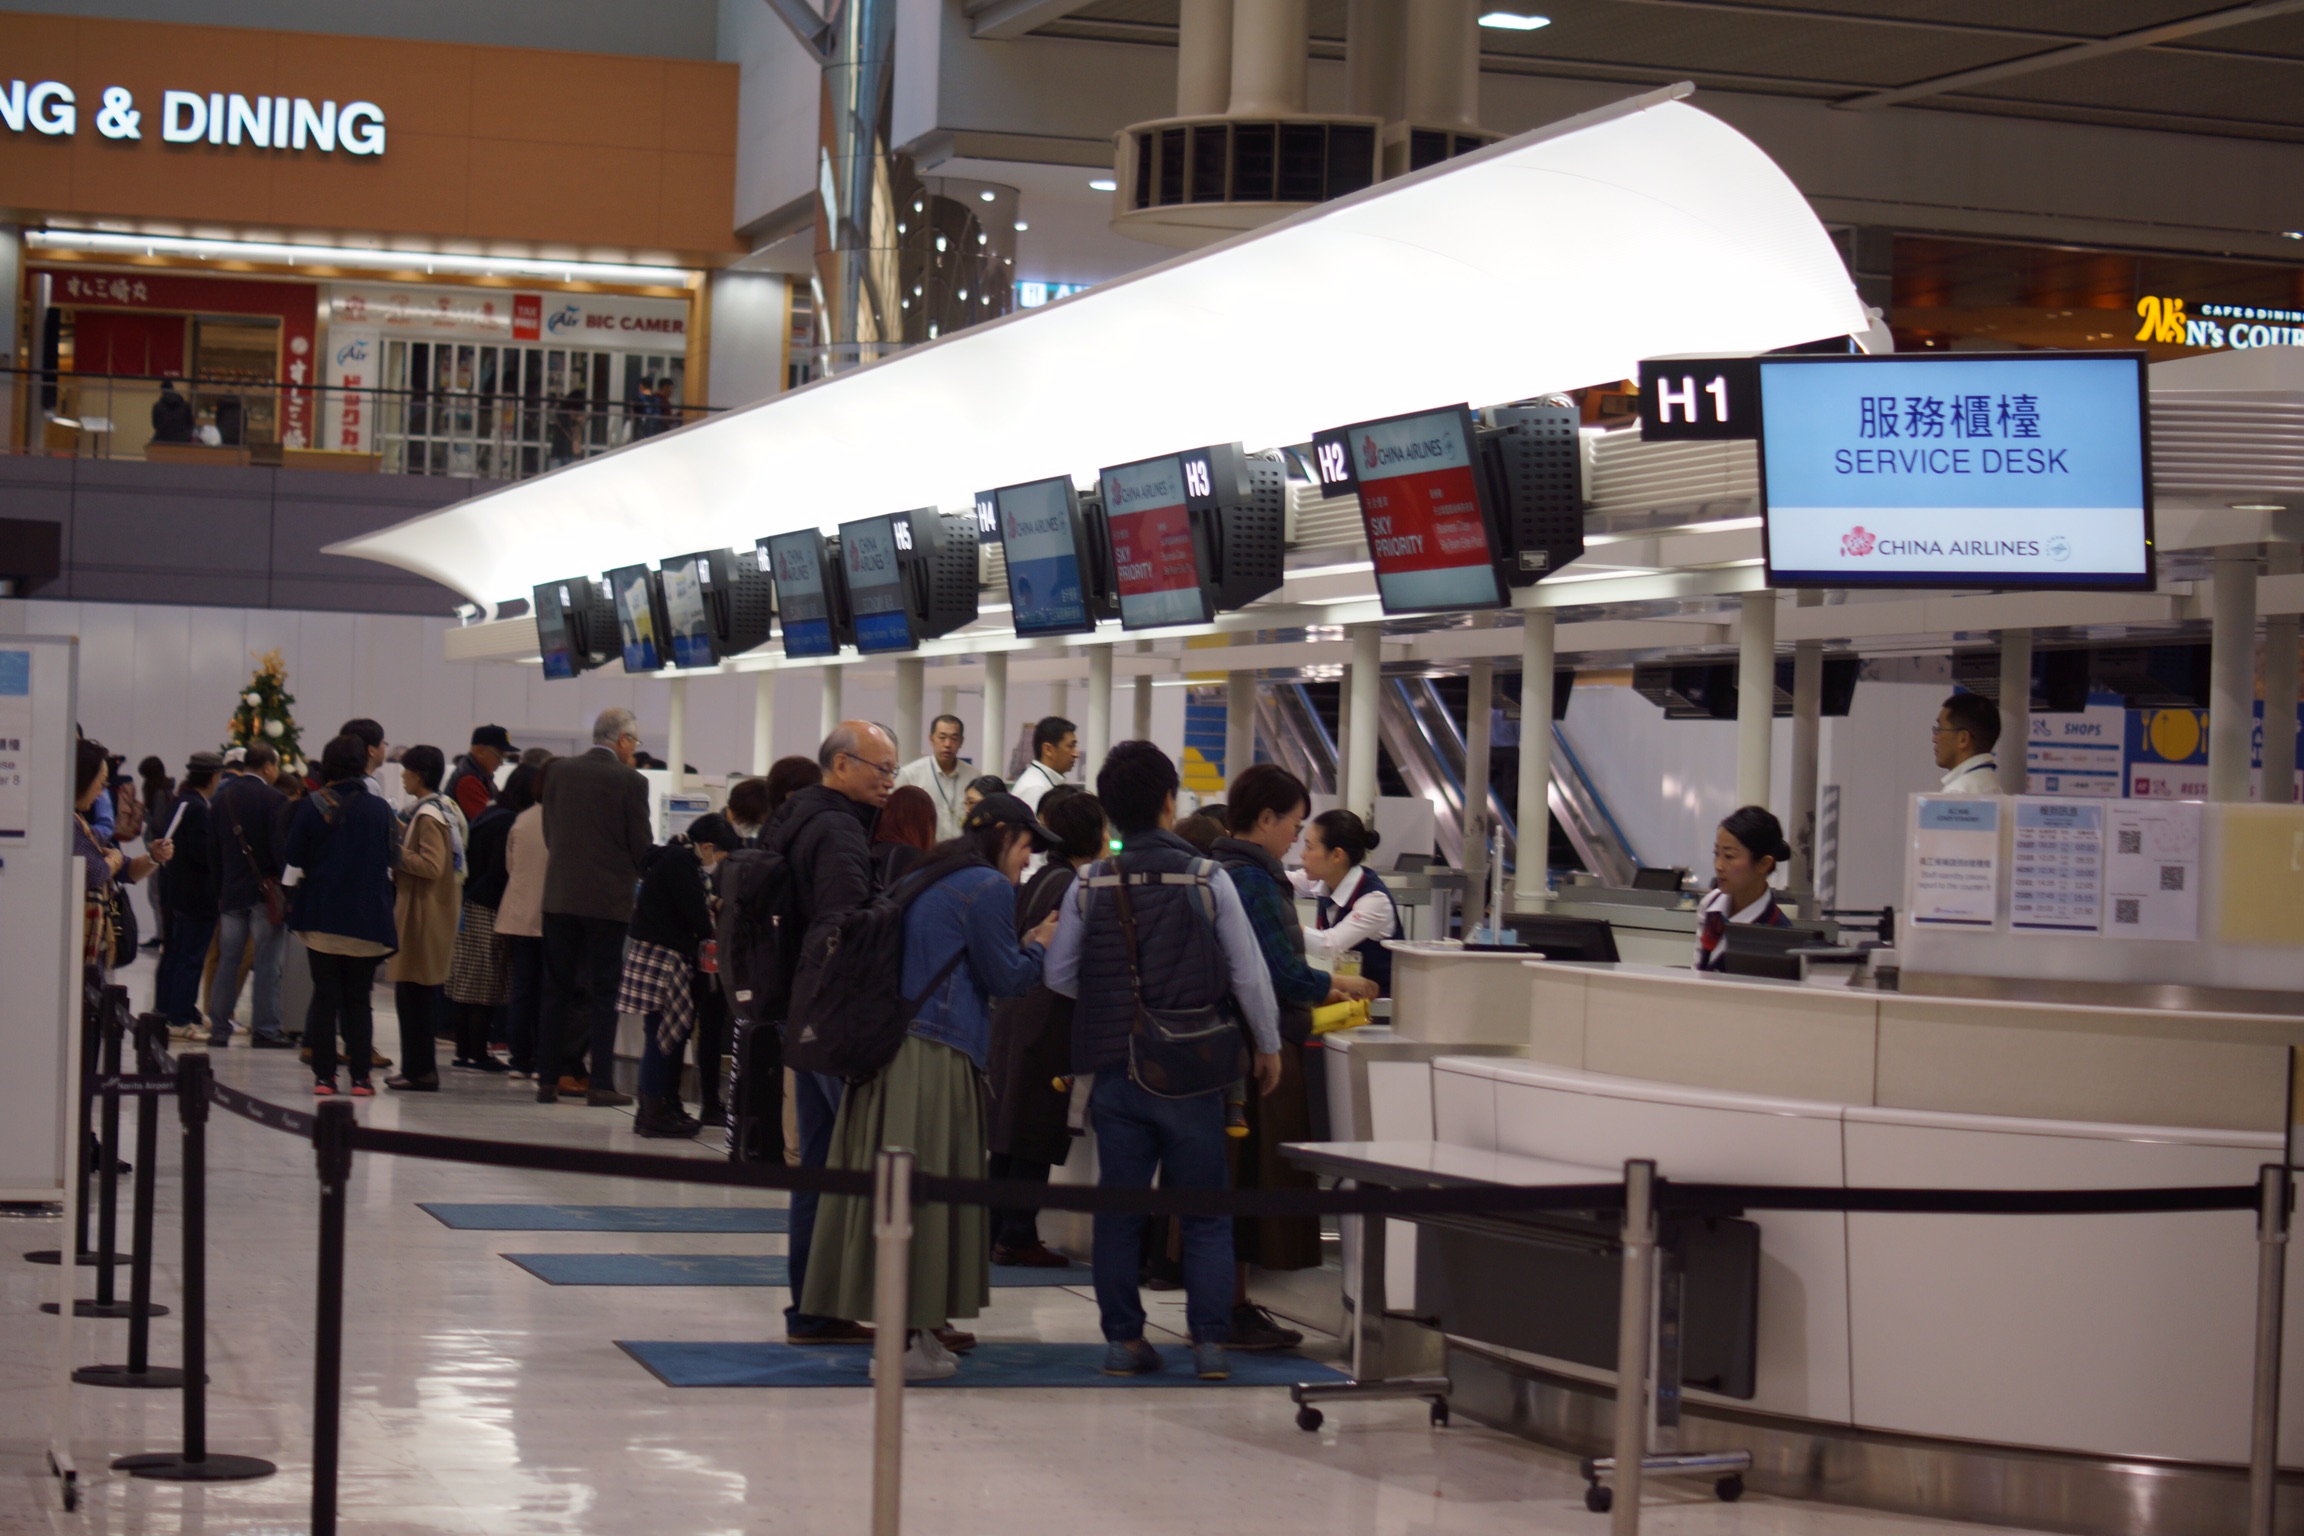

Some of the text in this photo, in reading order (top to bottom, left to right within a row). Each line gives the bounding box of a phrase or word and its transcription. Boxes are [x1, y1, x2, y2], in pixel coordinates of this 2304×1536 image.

[96, 86, 142, 139] &
[162, 90, 386, 155] DINING
[585, 314, 686, 334] BIC CAMER
[2200, 303, 2304, 322] CAFE&DININ
[1656, 375, 1729, 424] H1
[1858, 393, 2042, 439] 服務櫃檯
[1318, 443, 1348, 483] H2
[1378, 439, 1443, 466] CHINA AIRLINES
[1835, 448, 2069, 475] SERVICE DESK
[1185, 461, 1211, 497] H3
[1121, 480, 1168, 503] CHINA AIRLINES
[977, 501, 996, 532] H4
[1370, 515, 1392, 536] SKY
[893, 521, 913, 550] H5
[1374, 535, 1424, 557] PRIORITY
[1114, 546, 1131, 563] SKY
[1878, 540, 2040, 557] CHINA AIRLINES
[1117, 562, 1154, 582] PRIORITY
[2064, 722, 2103, 736] SHOPS
[118, 1081, 174, 1091] Narita Airport
